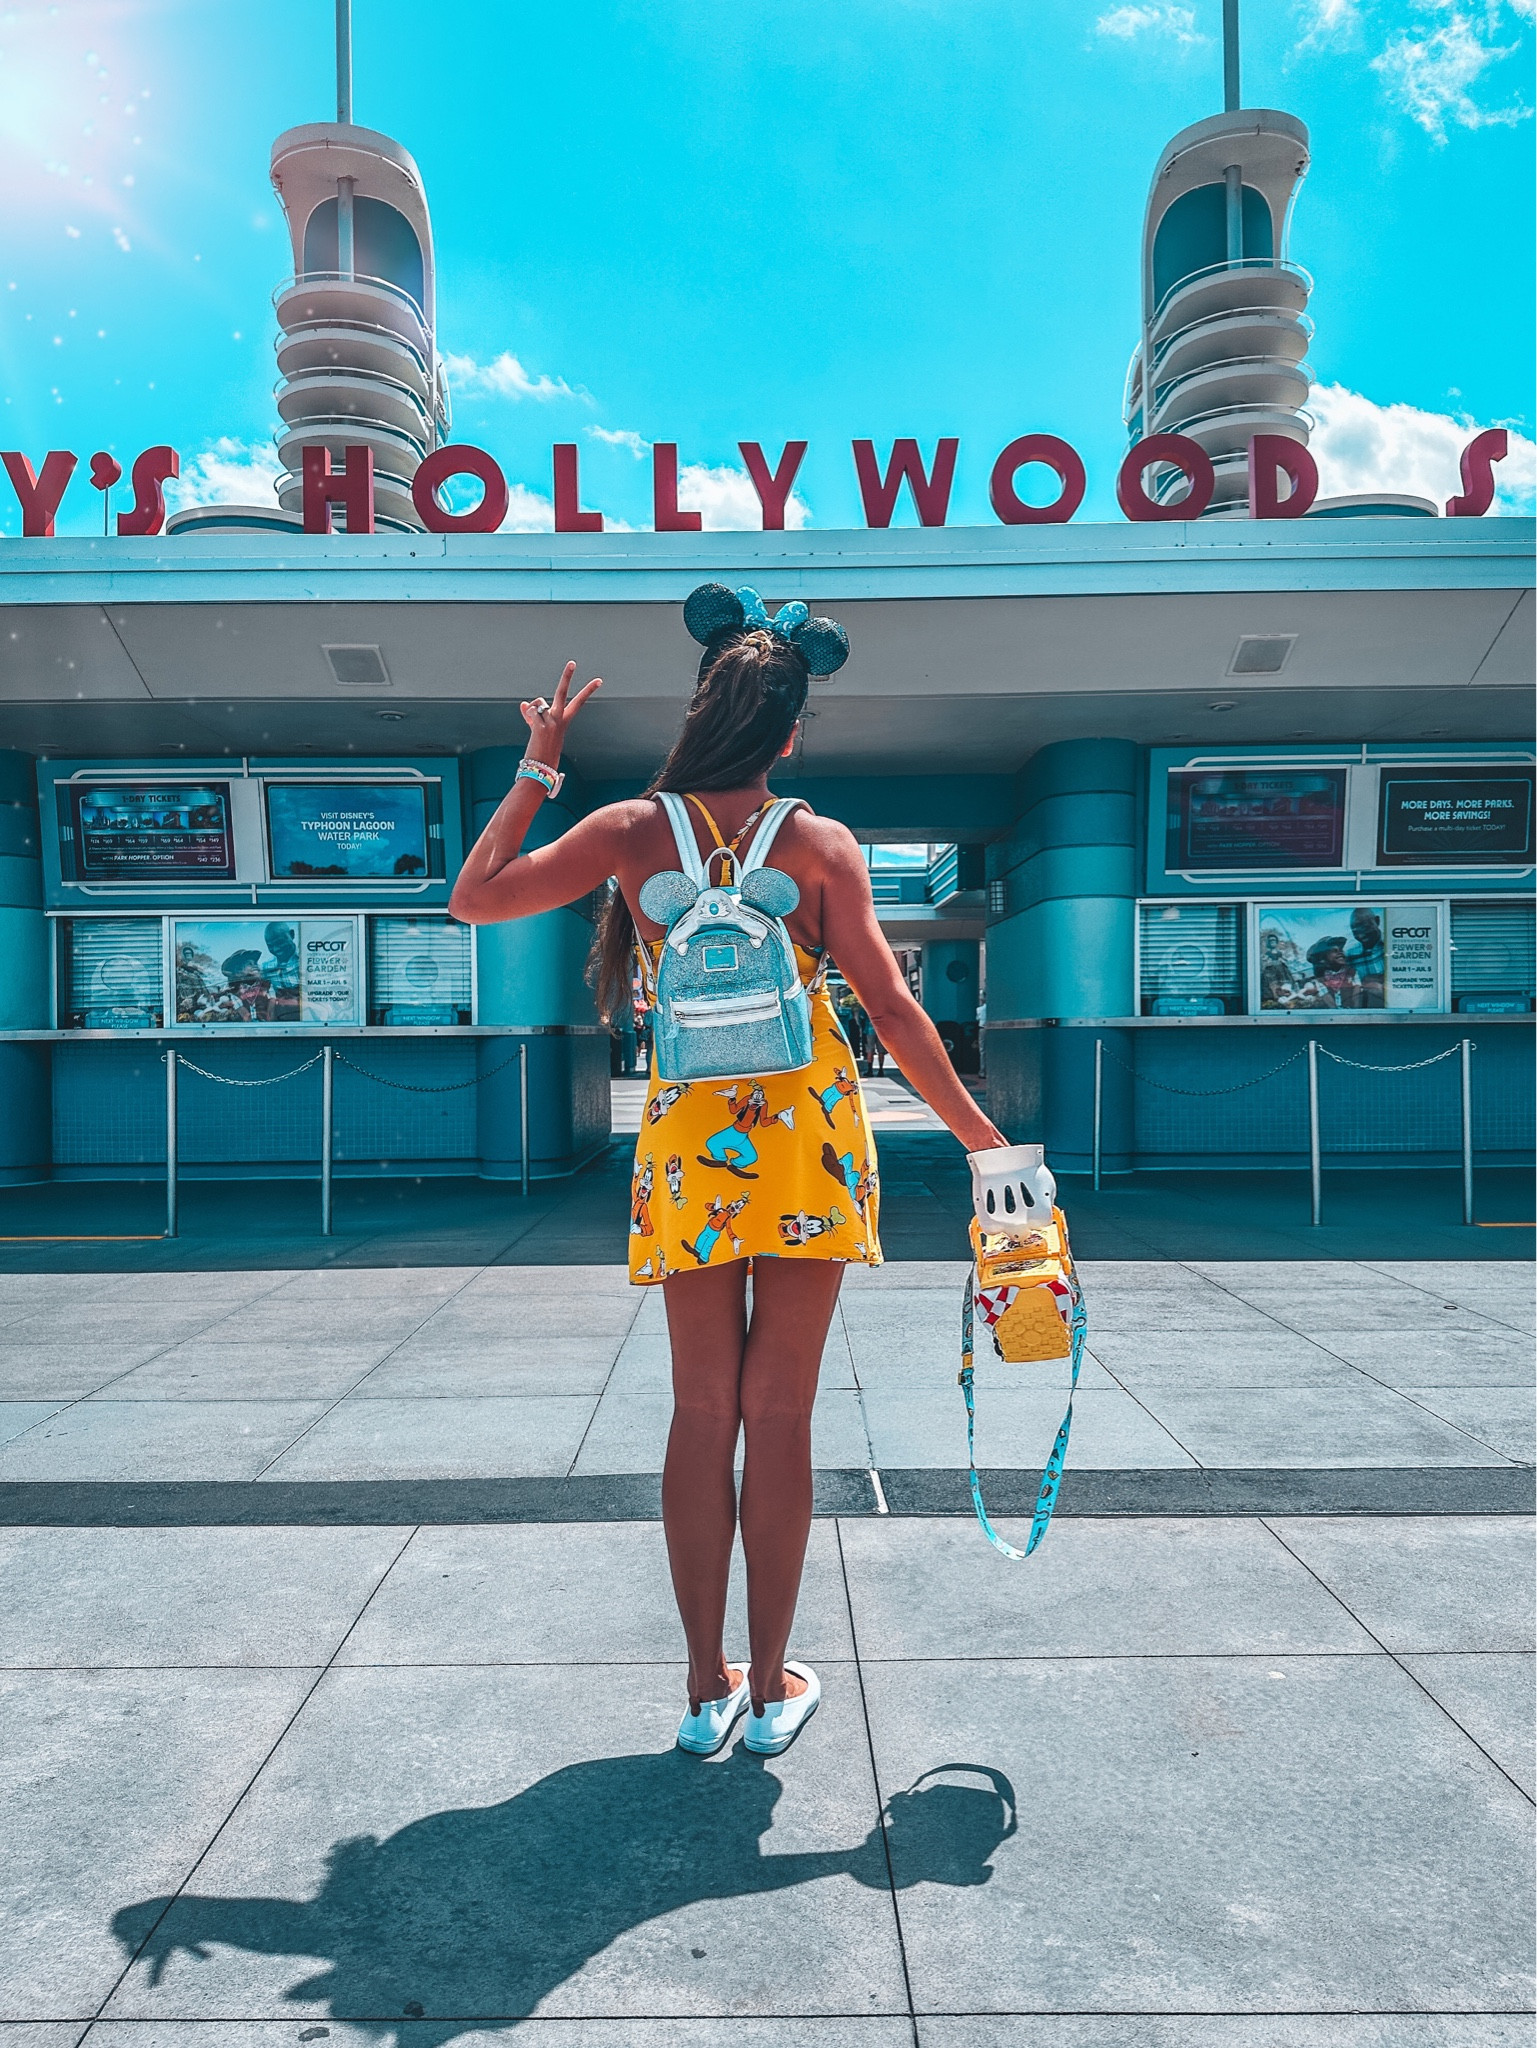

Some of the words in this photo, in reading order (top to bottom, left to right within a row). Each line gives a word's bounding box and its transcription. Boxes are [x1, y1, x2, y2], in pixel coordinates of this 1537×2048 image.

[303, 433, 1320, 535] HOLLYWOOD
[1401, 801, 1427, 809] MORE
[1430, 800, 1453, 808] DAYS.
[1456, 800, 1482, 808] MORE
[1485, 800, 1514, 808] PARKS.
[1424, 812, 1450, 820] MORE
[1453, 811, 1491, 819] SAVINGS!
[301, 822, 350, 830] TYPHOON
[353, 822, 394, 830] LAGOON
[318, 832, 350, 840] WATER
[354, 832, 379, 840] PARK
[1392, 928, 1431, 938] EPCOT
[307, 941, 347, 951] EPCOT
